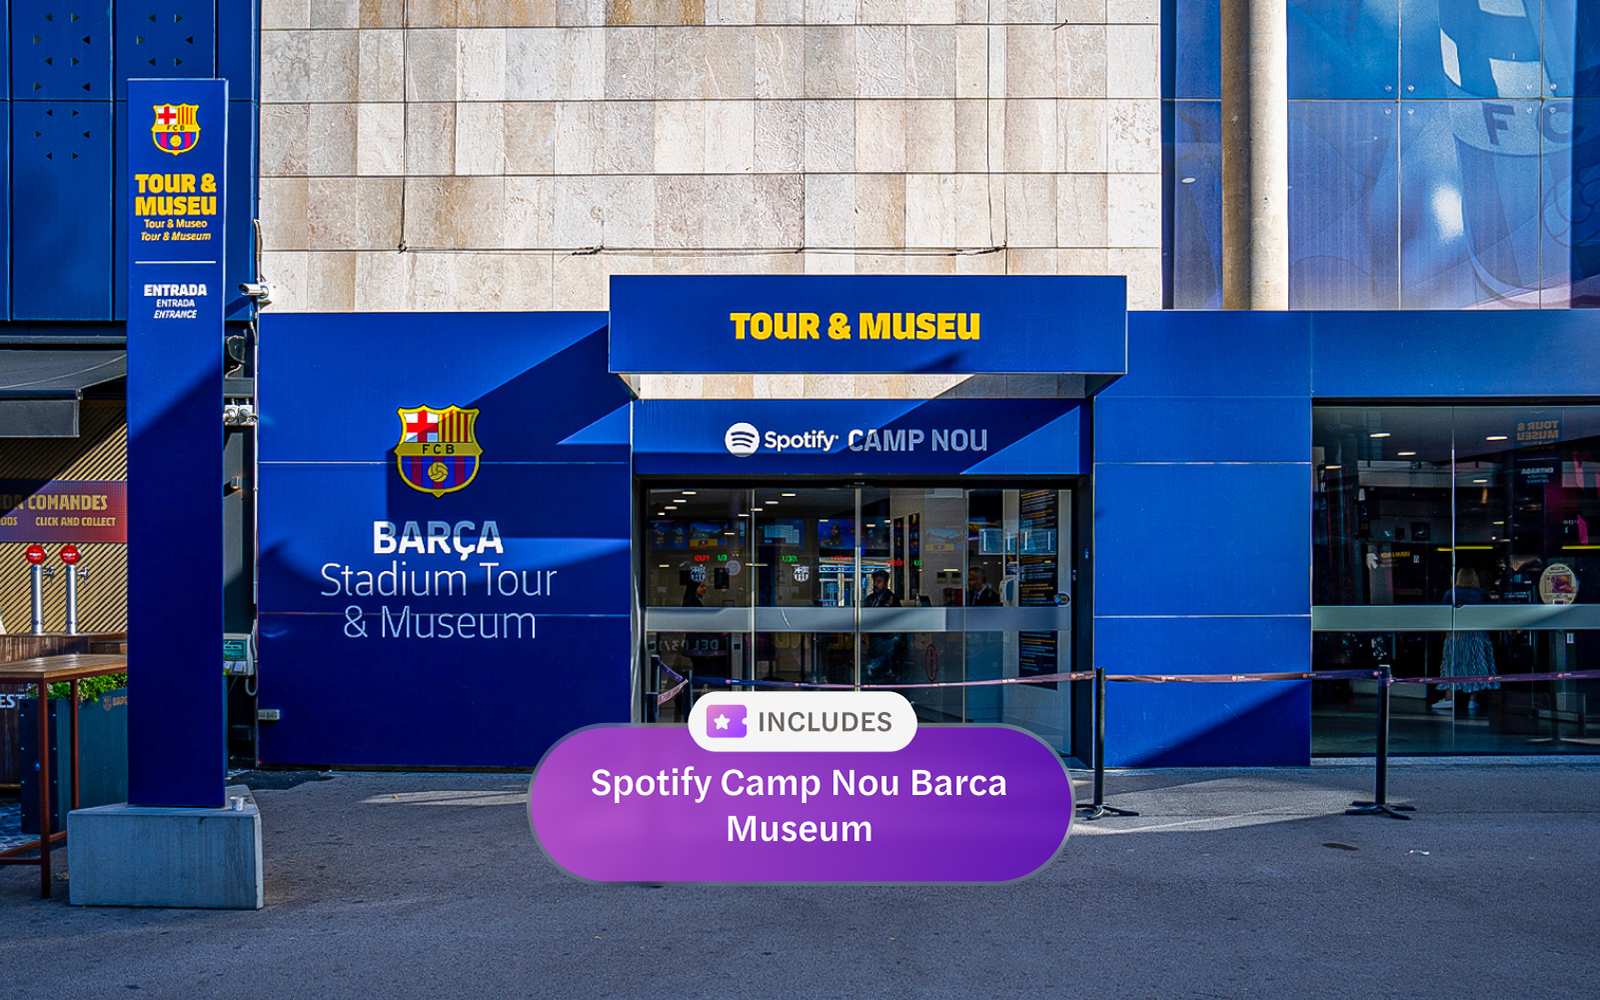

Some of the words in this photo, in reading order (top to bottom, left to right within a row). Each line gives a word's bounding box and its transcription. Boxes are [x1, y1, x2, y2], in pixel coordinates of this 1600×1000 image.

[134, 174, 196, 193] TOUR
[200, 173, 217, 193] &
[135, 196, 217, 216] MUSEU
[143, 219, 165, 229] Tour
[167, 219, 174, 228] &
[176, 219, 208, 228] Museo
[140, 232, 161, 241] Tour
[162, 232, 170, 241] &
[171, 232, 211, 241] Museum
[143, 284, 207, 296] ENTRADA
[156, 299, 195, 308] ENTRADA
[153, 309, 197, 319] ENTRANCE
[730, 312, 820, 340] TOUR
[827, 312, 851, 340] &
[859, 312, 981, 340] MUSEU
[764, 430, 835, 452] Spotify
[848, 429, 925, 452] CAMP
[931, 429, 987, 452] NOU
[27, 494, 108, 510] COMANDES
[35, 517, 59, 526] CLICK
[60, 517, 80, 526] AND
[81, 517, 116, 526] COLLECT
[373, 520, 504, 561] BARÇA
[320, 560, 468, 597] Stadium
[479, 562, 558, 597] Tour
[343, 605, 368, 638] &
[381, 605, 536, 638] Museum
